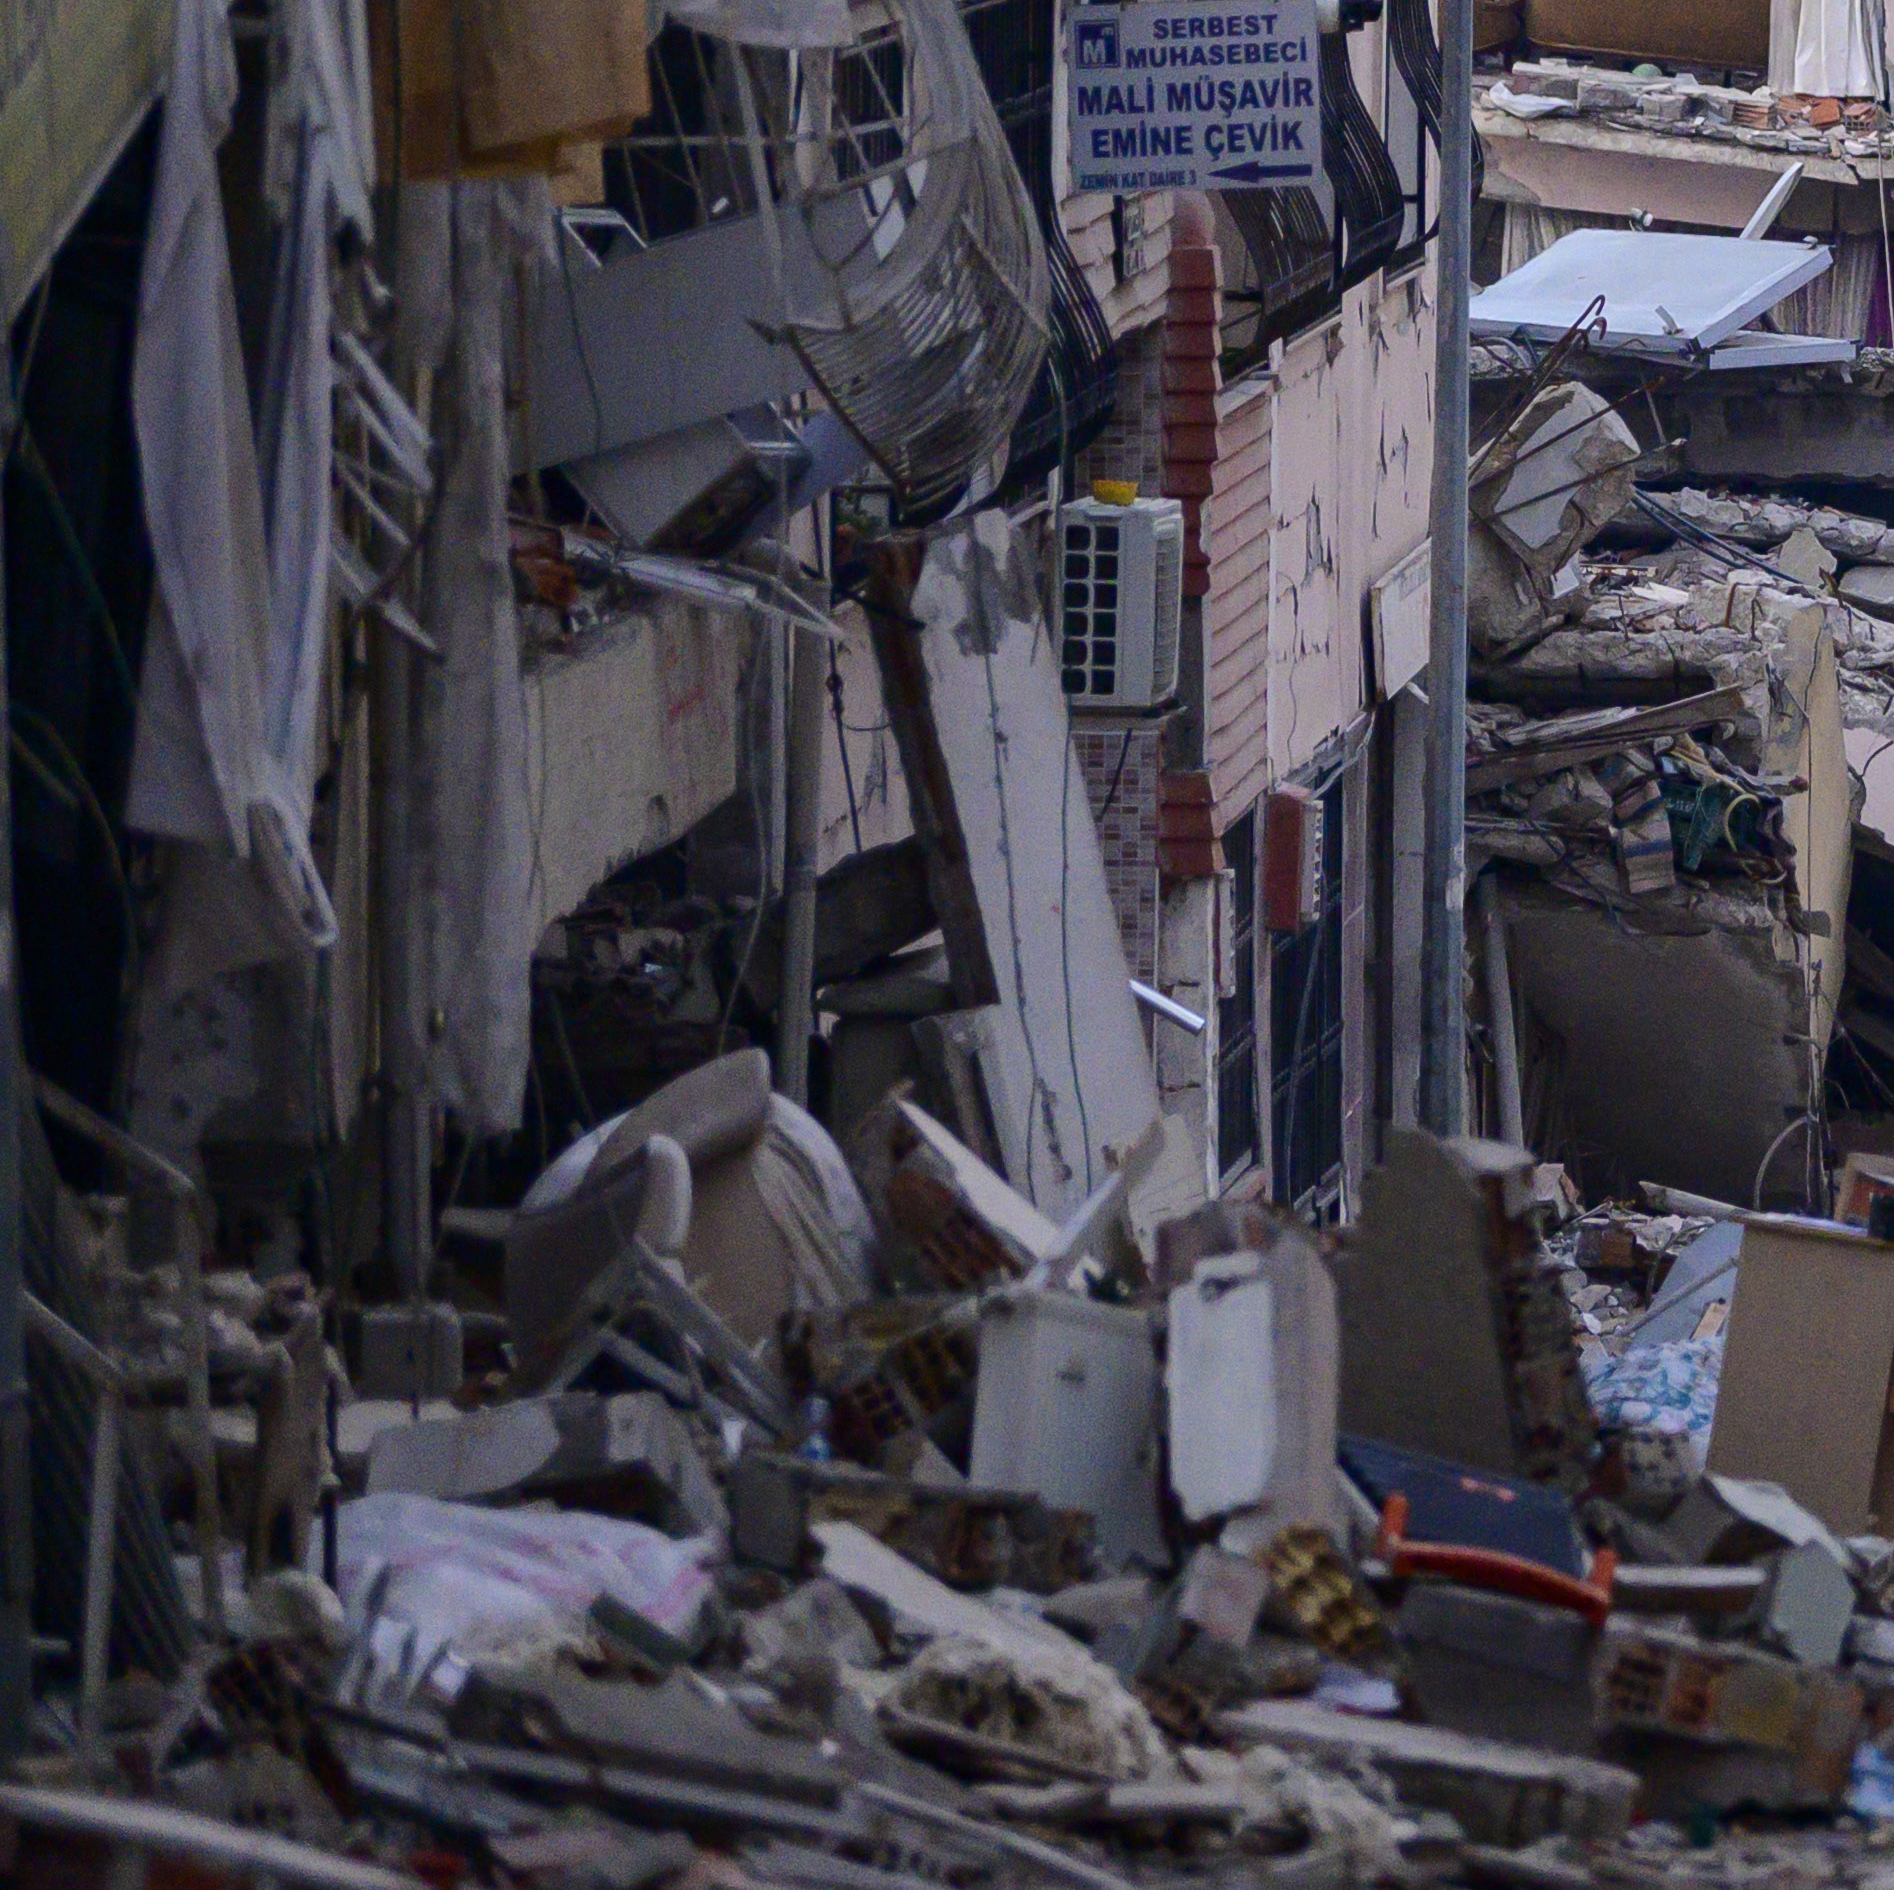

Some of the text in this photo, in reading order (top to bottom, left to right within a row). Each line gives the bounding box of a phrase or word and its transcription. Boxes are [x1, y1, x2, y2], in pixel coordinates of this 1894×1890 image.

[1152, 13, 1278, 39] SERBEST
[1125, 36, 1307, 70] MUHASEBECİ
[1077, 71, 1314, 118] MALİ MÜŞAVİR
[1091, 114, 1305, 161] EMİNE ÇEVİK
[1120, 173, 1147, 189] KAT
